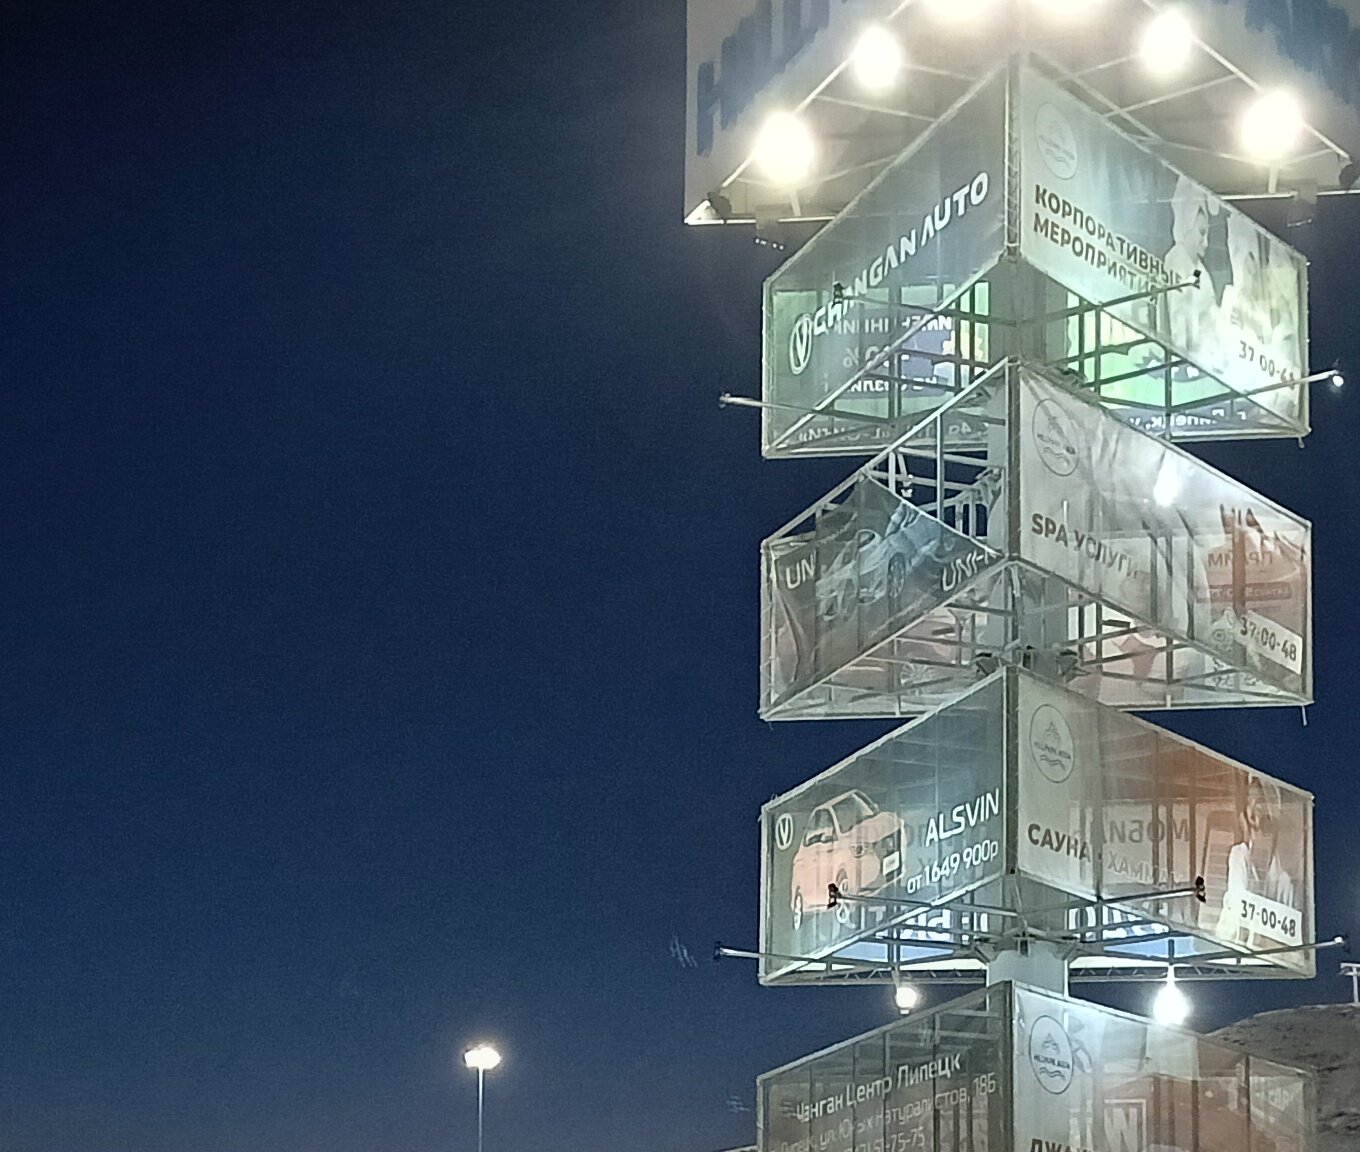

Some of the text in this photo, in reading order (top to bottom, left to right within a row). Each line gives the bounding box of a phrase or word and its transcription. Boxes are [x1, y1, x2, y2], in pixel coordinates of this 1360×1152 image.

[921, 171, 989, 247] AUTO
[1034, 184, 1183, 294] КОРПОРАТИВНЫЕ
[1031, 513, 1068, 547] SPA
[786, 549, 816, 589] UN
[1240, 616, 1297, 662] 37-00-48
[925, 787, 999, 848] ALSVIN
[1027, 823, 1092, 863] САУНА
[907, 874, 922, 894] от
[1240, 899, 1297, 937] 37-00-48
[796, 1053, 961, 1124] Чанган Центр Липецк
